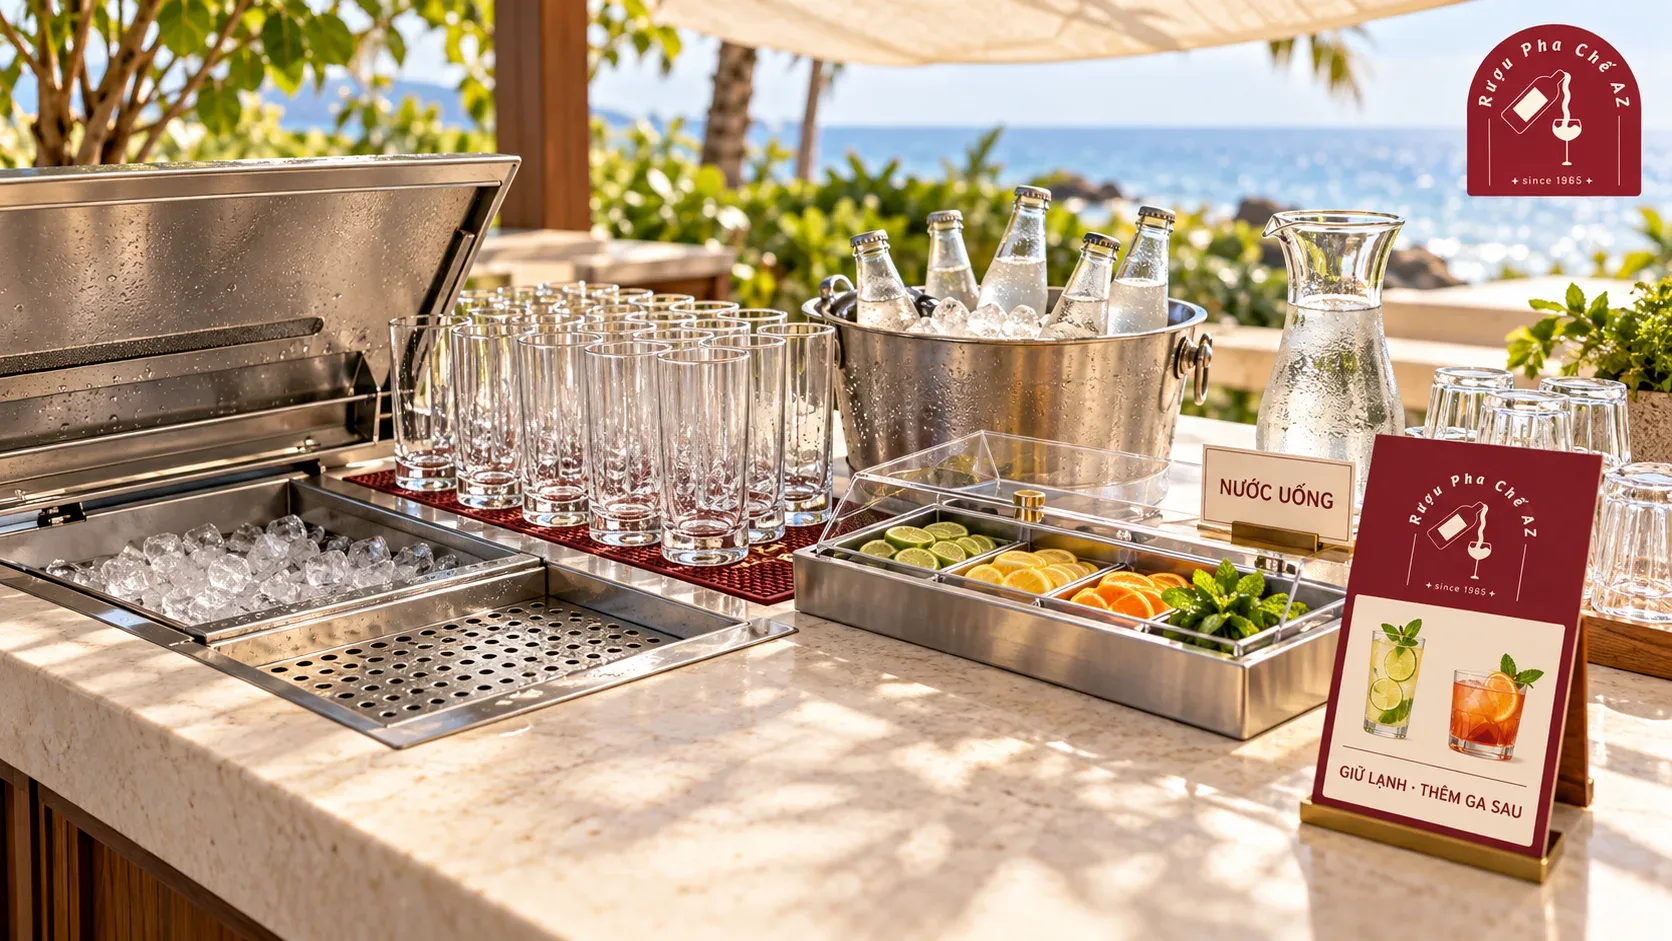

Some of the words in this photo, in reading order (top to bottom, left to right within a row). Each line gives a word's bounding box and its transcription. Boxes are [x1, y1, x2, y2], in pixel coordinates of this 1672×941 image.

[1220, 478, 1272, 501] NƯỚC
[1279, 483, 1333, 509] UỐNG
[1409, 485, 1443, 525] Rượu
[1450, 473, 1485, 487] Pha
[1495, 480, 1529, 507] Chế
[1521, 515, 1537, 537] AZ
[1434, 582, 1460, 592] since
[1339, 765, 1366, 781] GIỮ
[1368, 771, 1407, 792] LẠNH
[1420, 783, 1461, 804] THÊM
[1465, 794, 1486, 811] GA
[1491, 800, 1523, 818] SAU
